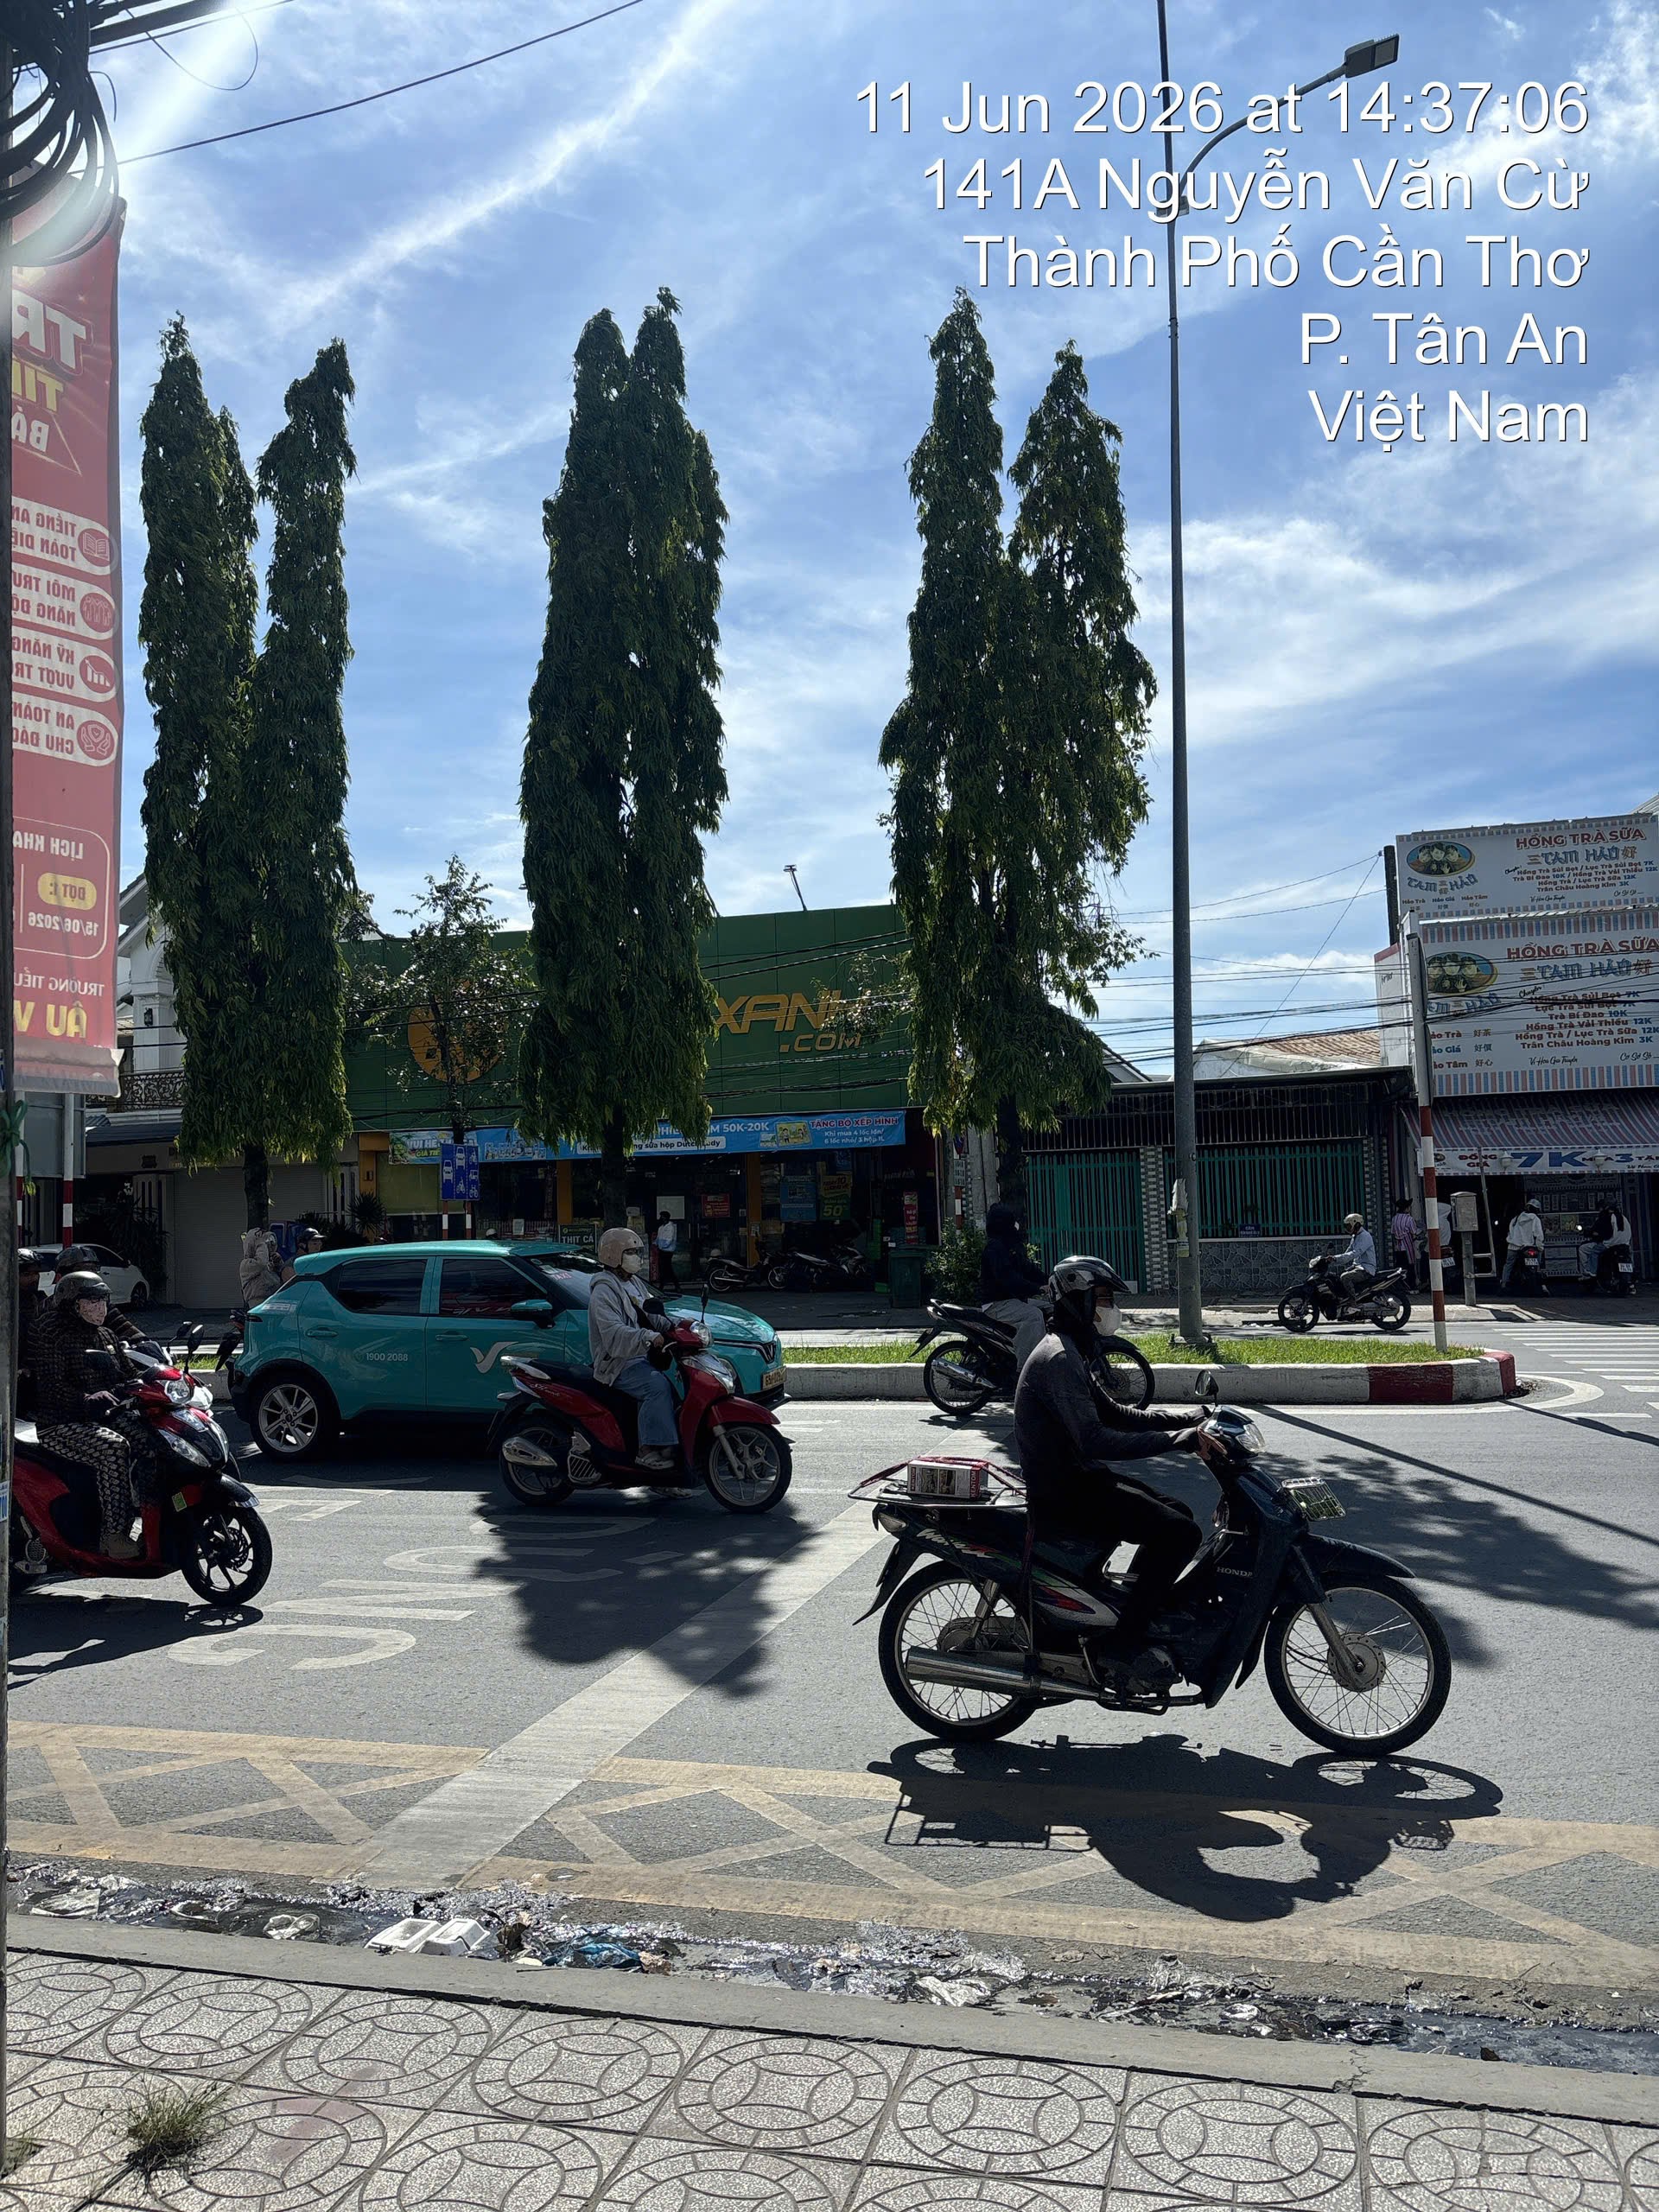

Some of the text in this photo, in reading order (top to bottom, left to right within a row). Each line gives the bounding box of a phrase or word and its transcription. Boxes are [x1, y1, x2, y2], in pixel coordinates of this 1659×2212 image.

[1516, 826, 1645, 849] HỒNG TRÀ SỮA
[1507, 936, 1659, 959] HỒNG TRÀ SỮA
[1557, 1020, 1575, 1029] Trà
[1516, 1032, 1542, 1041] Hồng
[1546, 1030, 1564, 1039] Trà
[1597, 1027, 1614, 1036] Trà
[779, 1033, 860, 1053] .COM
[723, 1122, 769, 1133] 50K-20K
[810, 1115, 899, 1129] TẶNG BỘ XẾP HÌNH
[1510, 1151, 1588, 1167] 7K
[1615, 1154, 1634, 1163] 3
[365, 1352, 385, 1361] 1900
